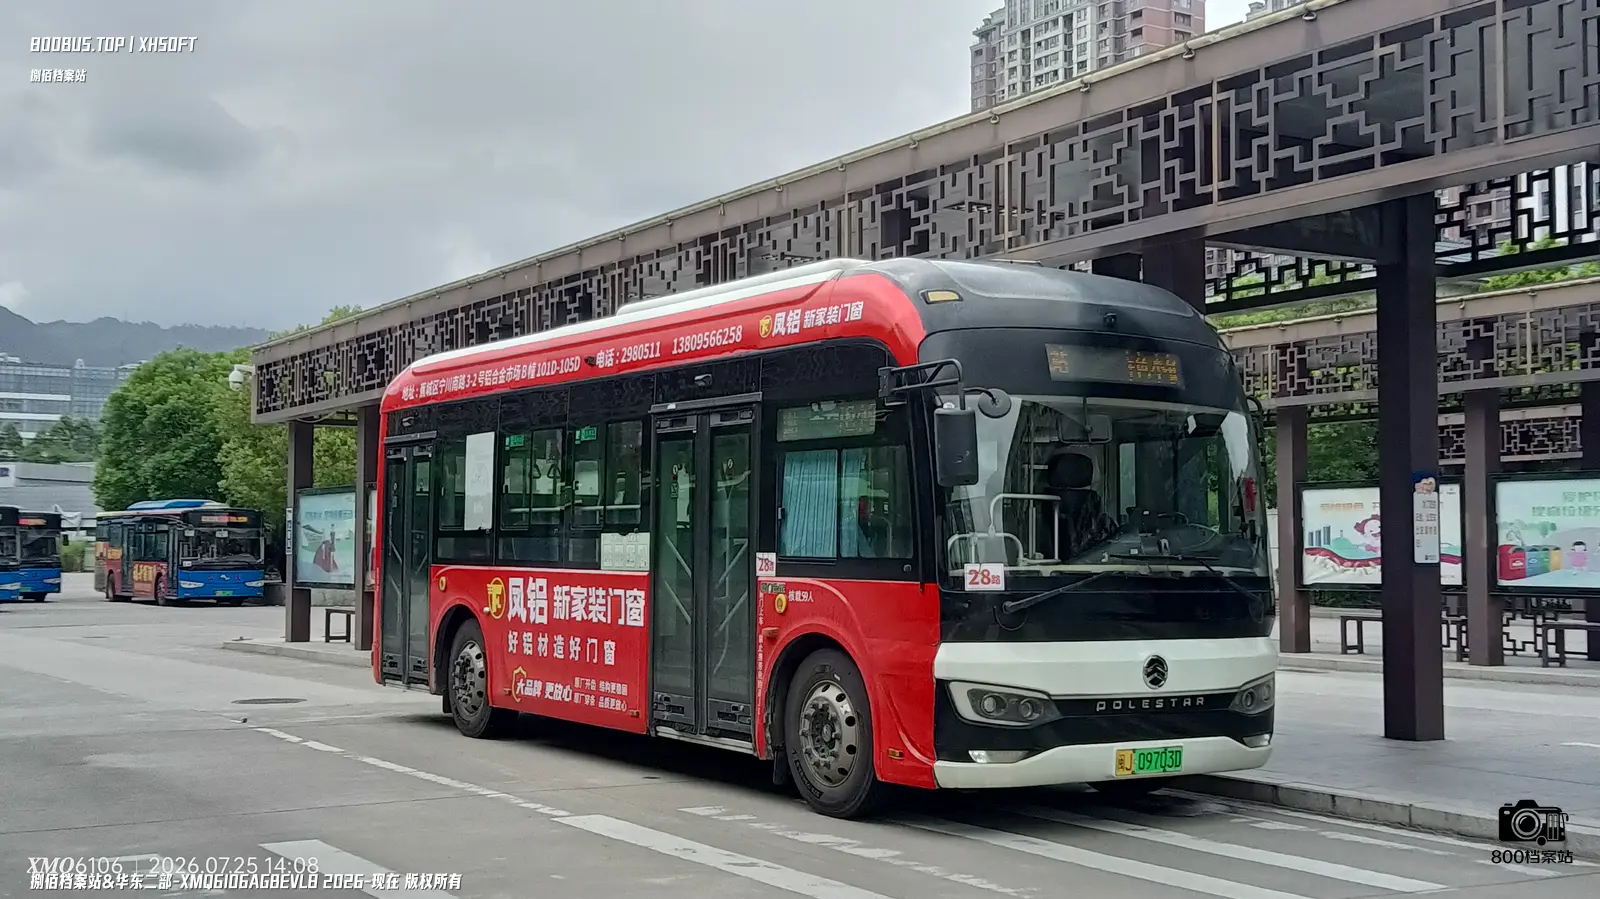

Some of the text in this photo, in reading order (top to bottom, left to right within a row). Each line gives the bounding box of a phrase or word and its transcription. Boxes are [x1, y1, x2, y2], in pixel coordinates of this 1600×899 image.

[772, 301, 864, 337] 凤铝 新家装门窗
[672, 325, 743, 354] 13809566258
[968, 569, 1001, 585] 28路
[507, 576, 646, 627] 凤铝 新家装门窗
[507, 630, 616, 666] 好铝材造好门窗
[515, 678, 573, 702] 大品牌 更放心
[1096, 697, 1205, 712] POLESTAR
[1137, 750, 1182, 771] 09703D
